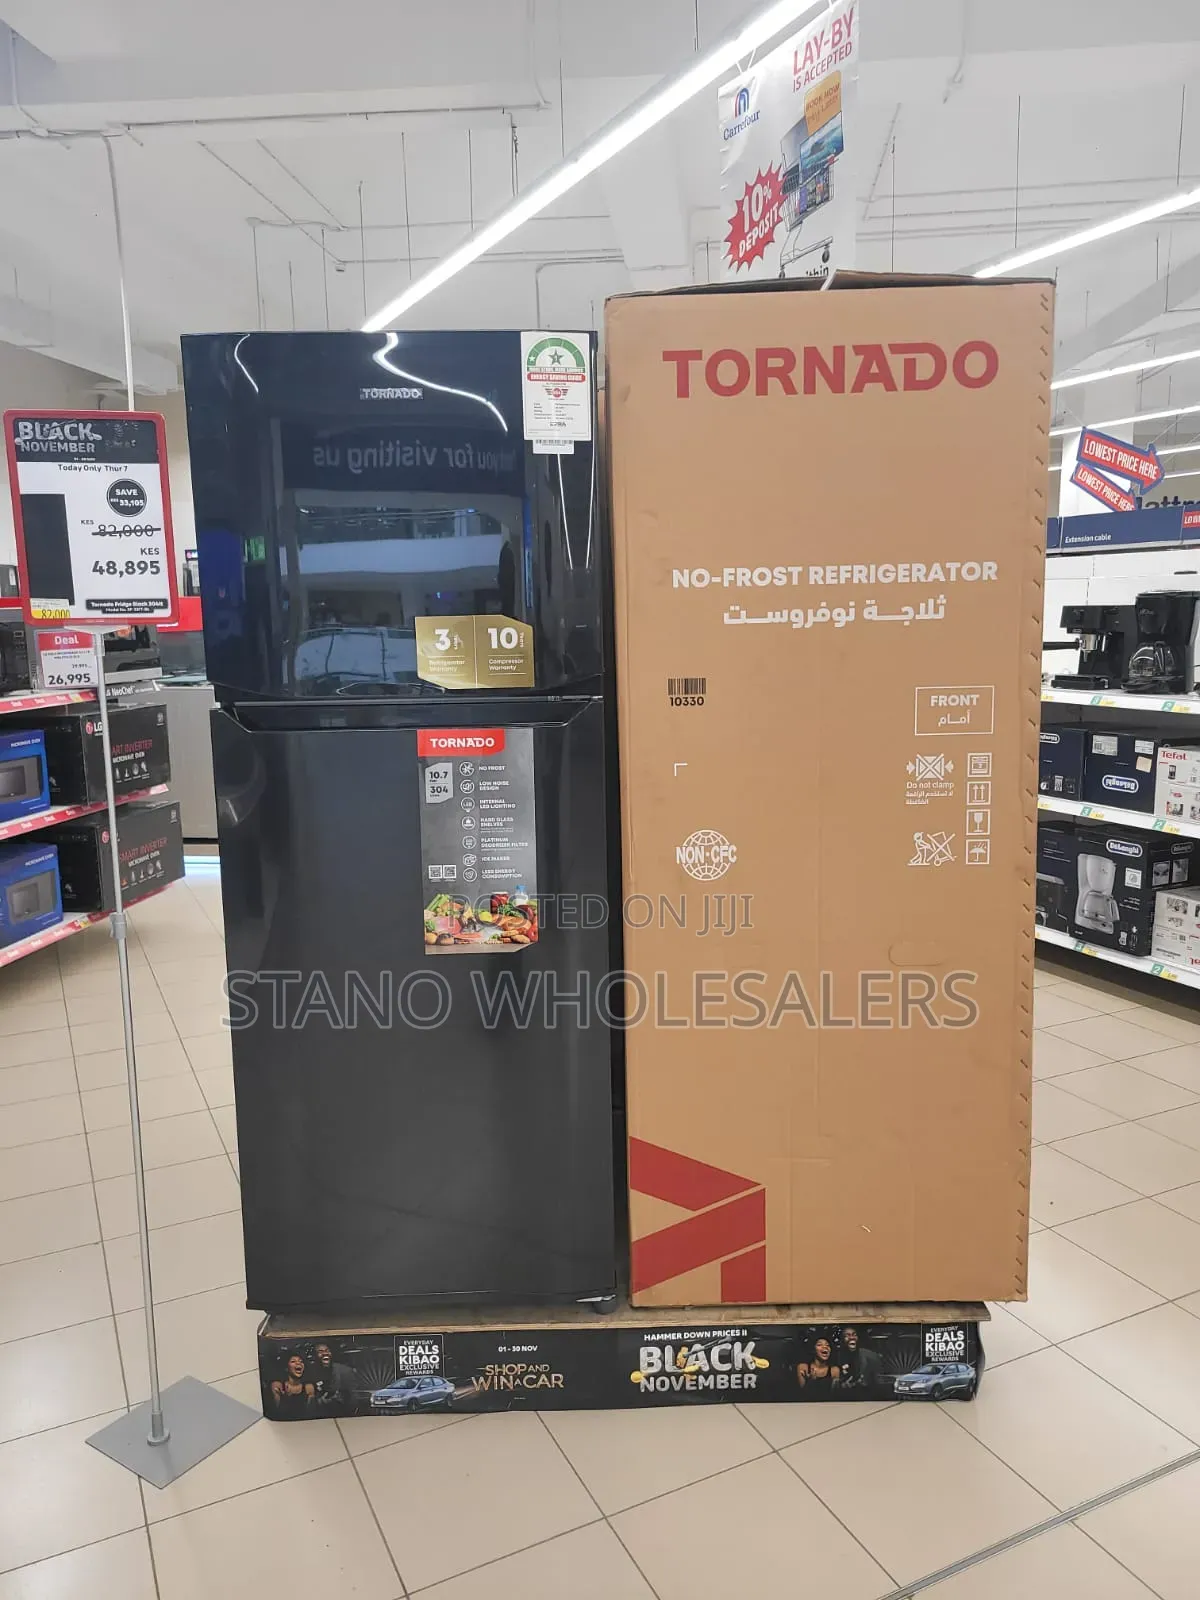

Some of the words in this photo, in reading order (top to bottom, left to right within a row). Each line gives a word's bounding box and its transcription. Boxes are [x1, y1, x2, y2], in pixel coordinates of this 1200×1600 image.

[793, 7, 854, 76] LAY-BY
[793, 79, 801, 93] IS
[804, 41, 852, 89] ACCEPTED
[723, 110, 760, 141] Carrefour
[743, 181, 772, 233] 10%
[739, 202, 778, 258] DEPOSIT
[662, 340, 999, 399] TORNADO
[363, 388, 421, 399] TORNADO
[18, 421, 97, 441] BLACK
[20, 441, 95, 453] NOVEMBER
[1084, 438, 1116, 464] LOWEST
[1117, 452, 1137, 472] PRICE
[1139, 461, 1158, 480] HERE
[58, 464, 82, 472] Today
[84, 464, 102, 472] Only
[1077, 468, 1103, 492] LOWEST
[1103, 485, 1119, 505] PRICE
[97, 524, 155, 540] 82,000
[1065, 535, 1094, 544] Extension
[1094, 533, 1112, 541] cable
[140, 547, 160, 555] KES
[92, 560, 161, 578] 48,895
[672, 566, 803, 588] NO-FROST
[809, 561, 998, 585] REFRIGERATOR
[54, 635, 79, 645] Deal
[434, 628, 451, 651] 3
[488, 627, 518, 649] 10
[49, 673, 91, 686] 26,995
[670, 697, 704, 707] 10330
[931, 694, 980, 706] FRONT
[938, 709, 971, 727] أمام
[94, 721, 103, 732] LG
[430, 738, 495, 748] TORNADO
[1161, 751, 1187, 760] Tefal
[430, 771, 448, 779] 10.7
[430, 786, 448, 794] 304
[932, 781, 955, 790] clamp
[1109, 842, 1139, 854] DeLonghi
[1154, 966, 1160, 974] 2
[644, 1333, 682, 1341] HAMMER
[684, 1331, 711, 1339] DOWN
[712, 1329, 740, 1337] PRICES
[925, 1331, 965, 1342] DEALS
[399, 1345, 439, 1355] DEALS
[925, 1341, 965, 1351] KIBAO
[399, 1355, 440, 1365] KIBAO
[639, 1341, 757, 1374] BLACK
[399, 1363, 440, 1371] EXCLUSIVE
[485, 1364, 527, 1376] SHOP
[528, 1364, 550, 1372] AND
[472, 1375, 515, 1391] WIN
[514, 1378, 522, 1386] A
[522, 1374, 564, 1389] CAR
[640, 1373, 757, 1393] NOVEMBER
